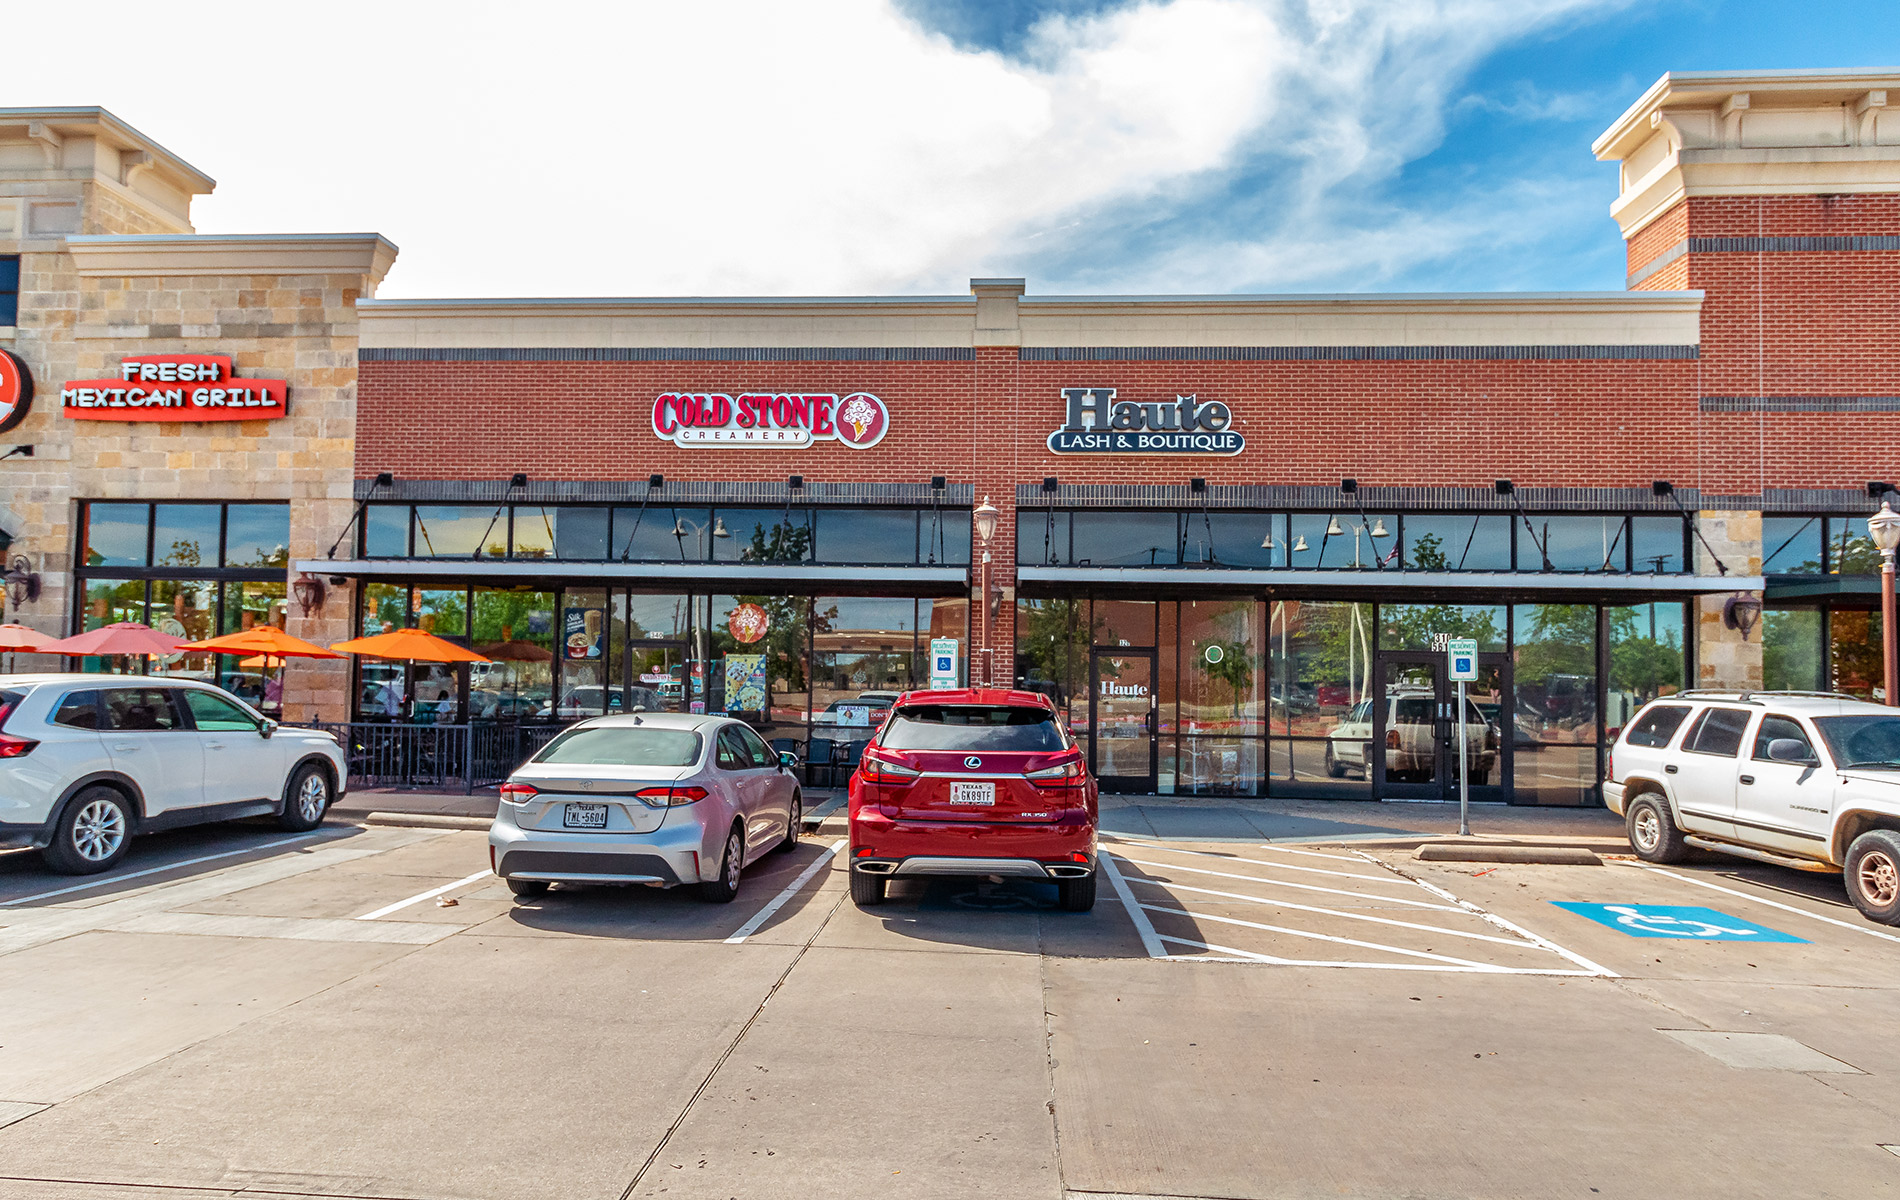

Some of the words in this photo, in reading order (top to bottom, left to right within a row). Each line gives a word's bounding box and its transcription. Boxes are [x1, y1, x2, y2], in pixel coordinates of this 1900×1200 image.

[122, 362, 219, 381] FRESH
[60, 388, 182, 407] MEXICAN
[191, 388, 277, 407] GRILL
[654, 394, 731, 435] COLD
[736, 395, 834, 435] STONE
[1064, 389, 1230, 431] Haute
[683, 431, 801, 440] CREAMERY
[1060, 435, 1110, 448] LASH
[1116, 435, 1129, 448] &
[1138, 435, 1236, 451] BOUTIQUE
[1101, 681, 1148, 695] Haute
[961, 790, 991, 801] GK89TF
